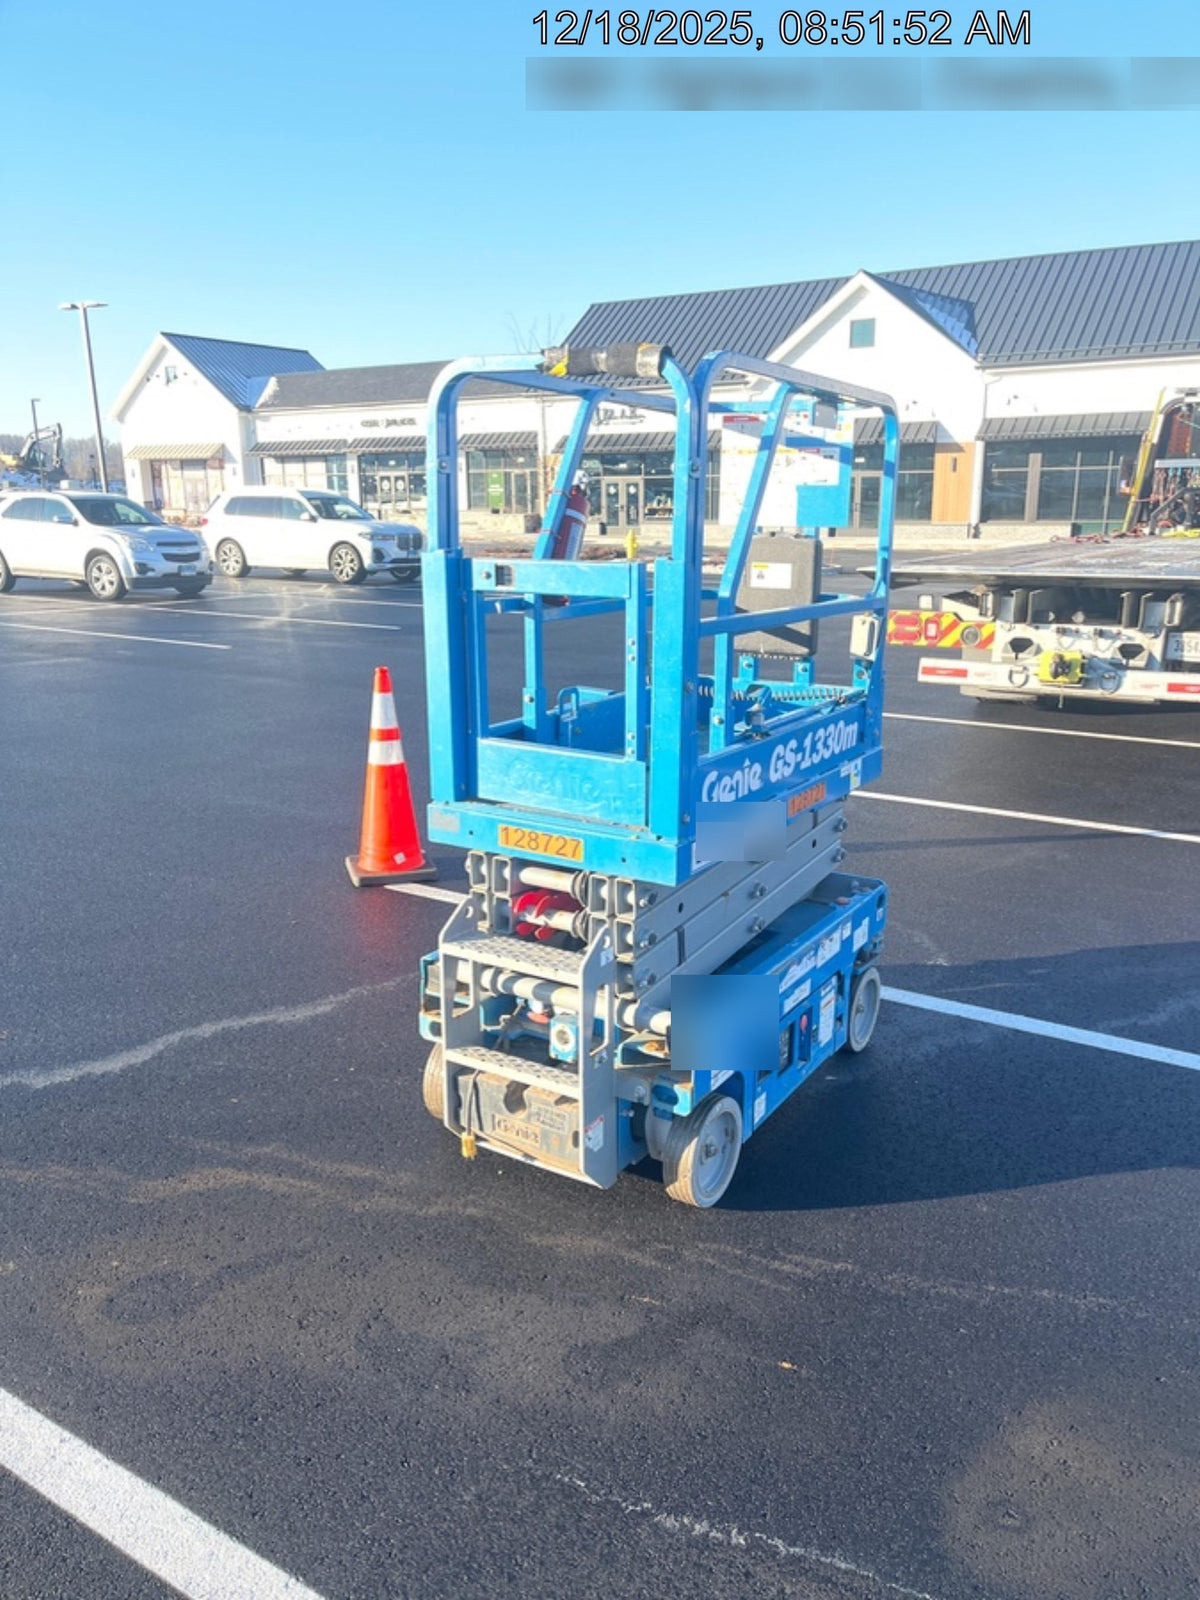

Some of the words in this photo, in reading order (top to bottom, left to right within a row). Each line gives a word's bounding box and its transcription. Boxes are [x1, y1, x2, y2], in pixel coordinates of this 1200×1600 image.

[701, 757, 763, 802] Genie
[769, 720, 859, 783] GS-1330m
[501, 826, 582, 859] 128727
